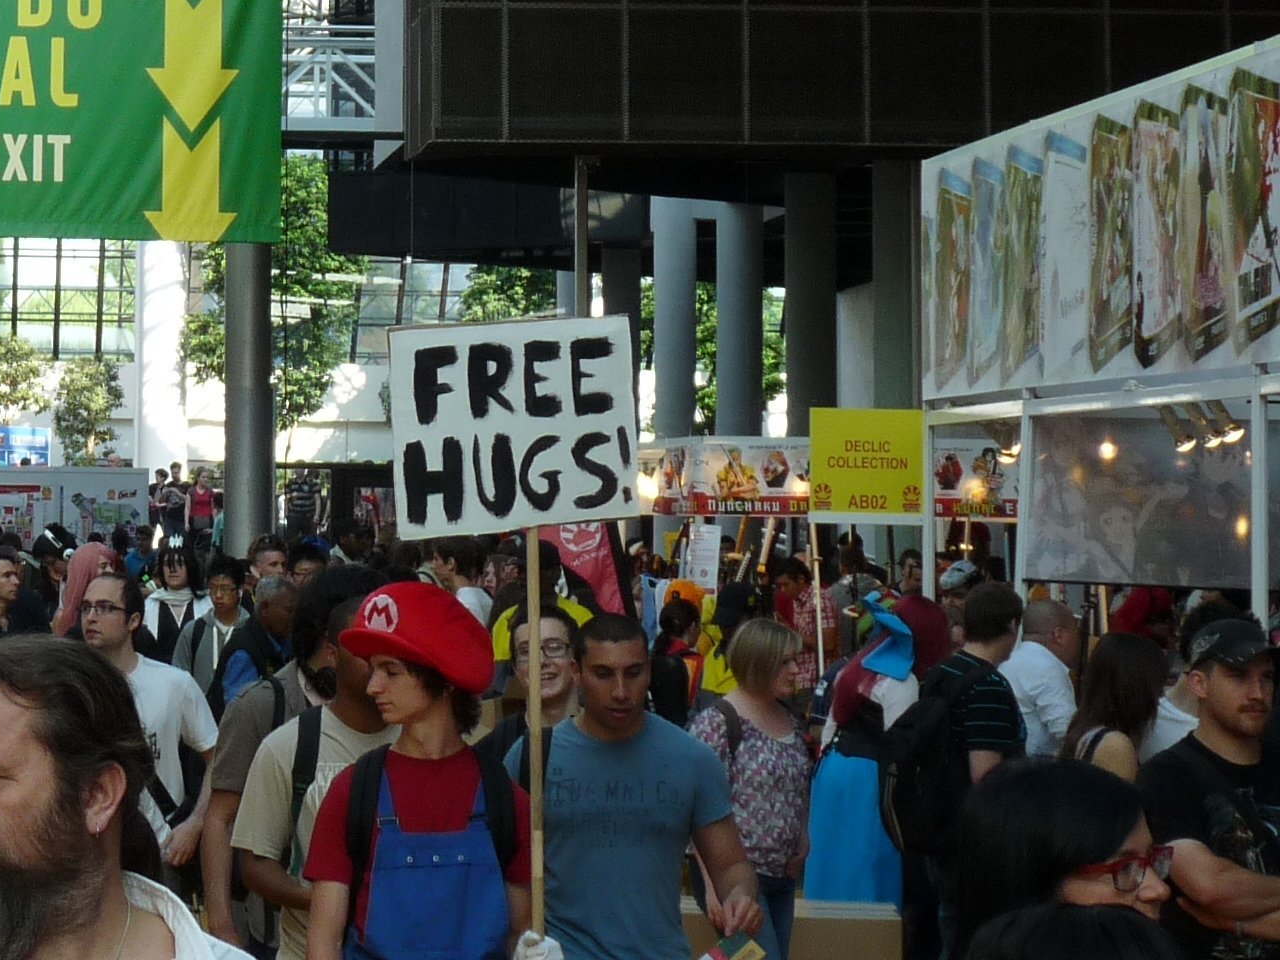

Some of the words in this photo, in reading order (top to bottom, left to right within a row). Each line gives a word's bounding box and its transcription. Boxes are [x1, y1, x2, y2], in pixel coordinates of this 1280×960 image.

[414, 336, 614, 425] FREE
[844, 440, 891, 453] DECLIC
[827, 456, 909, 470] COLLECTION
[403, 426, 632, 526] HUGS!
[848, 494, 888, 510] AB02
[366, 601, 395, 628] M
